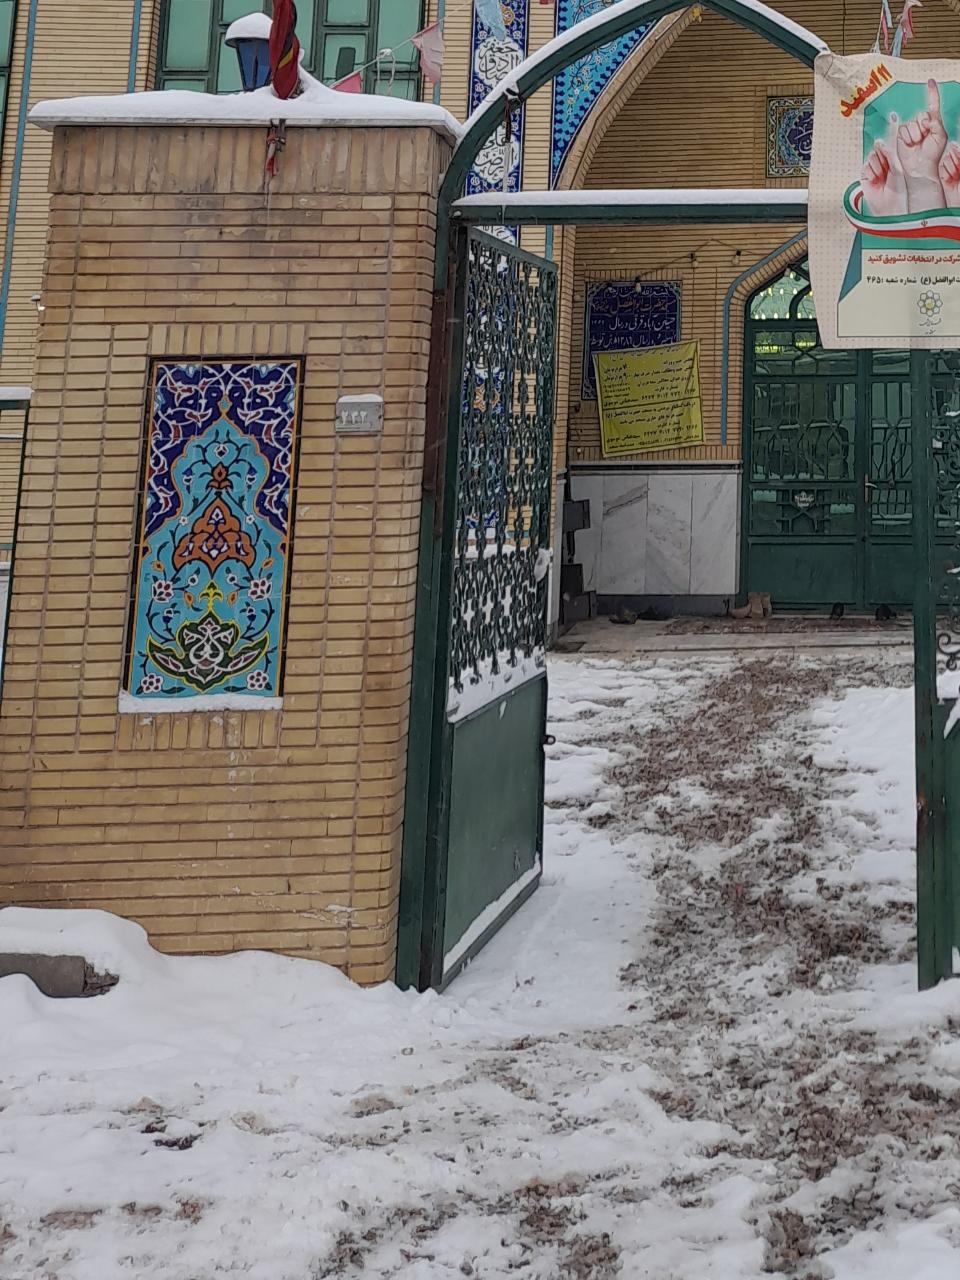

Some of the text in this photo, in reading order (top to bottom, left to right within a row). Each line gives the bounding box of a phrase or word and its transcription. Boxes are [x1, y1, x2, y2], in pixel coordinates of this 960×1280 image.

[840, 69, 882, 118] اسفند
[867, 254, 883, 263] کنید
[882, 253, 907, 265] تشویق
[906, 254, 935, 265] انتخابات
[899, 276, 917, 286] شماره
[934, 275, 956, 286] ابوالفضل
